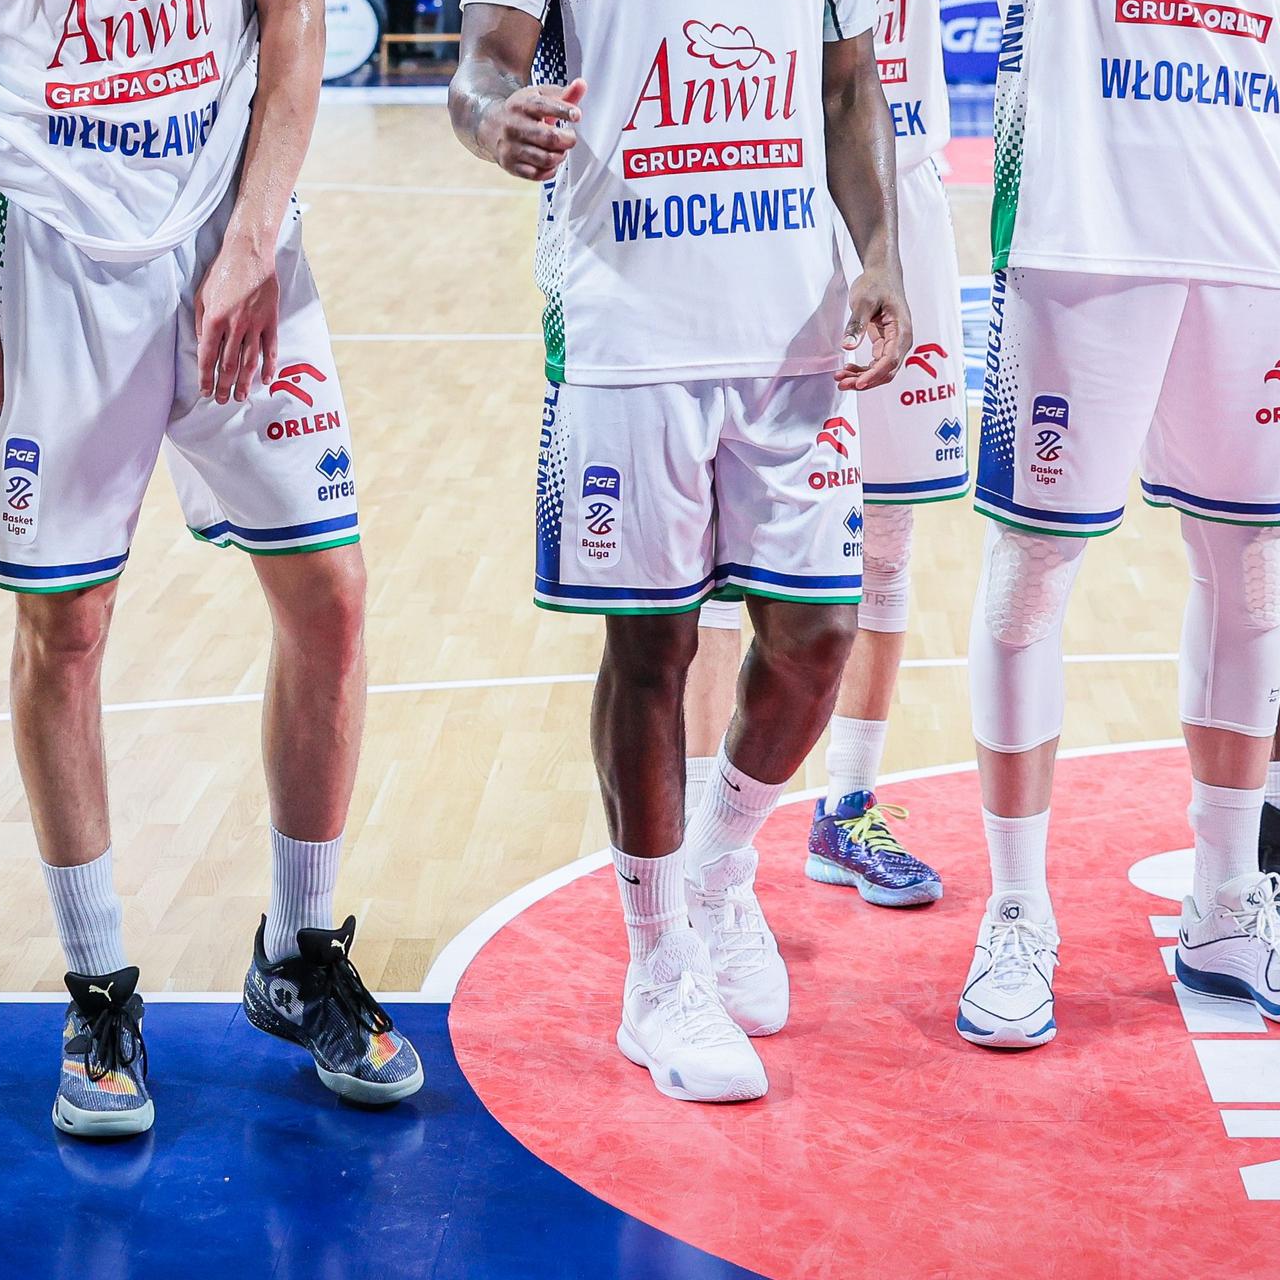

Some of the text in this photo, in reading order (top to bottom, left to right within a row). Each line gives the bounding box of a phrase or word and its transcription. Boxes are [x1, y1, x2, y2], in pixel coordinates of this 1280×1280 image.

[622, 37, 798, 132] Anwil
[612, 187, 816, 242] WŁOCŁAWEK
[899, 382, 956, 407] ORLEN
[1035, 405, 1066, 419] PGE
[267, 410, 341, 441] ORLEN
[6, 448, 36, 463] PGE
[1030, 464, 1063, 476] Basket
[586, 475, 617, 489] PGE
[1036, 475, 1057, 486] Liga
[2, 512, 33, 526] Basket
[7, 524, 27, 536] Liga
[582, 539, 617, 549] Basket
[588, 548, 609, 560] Liga
